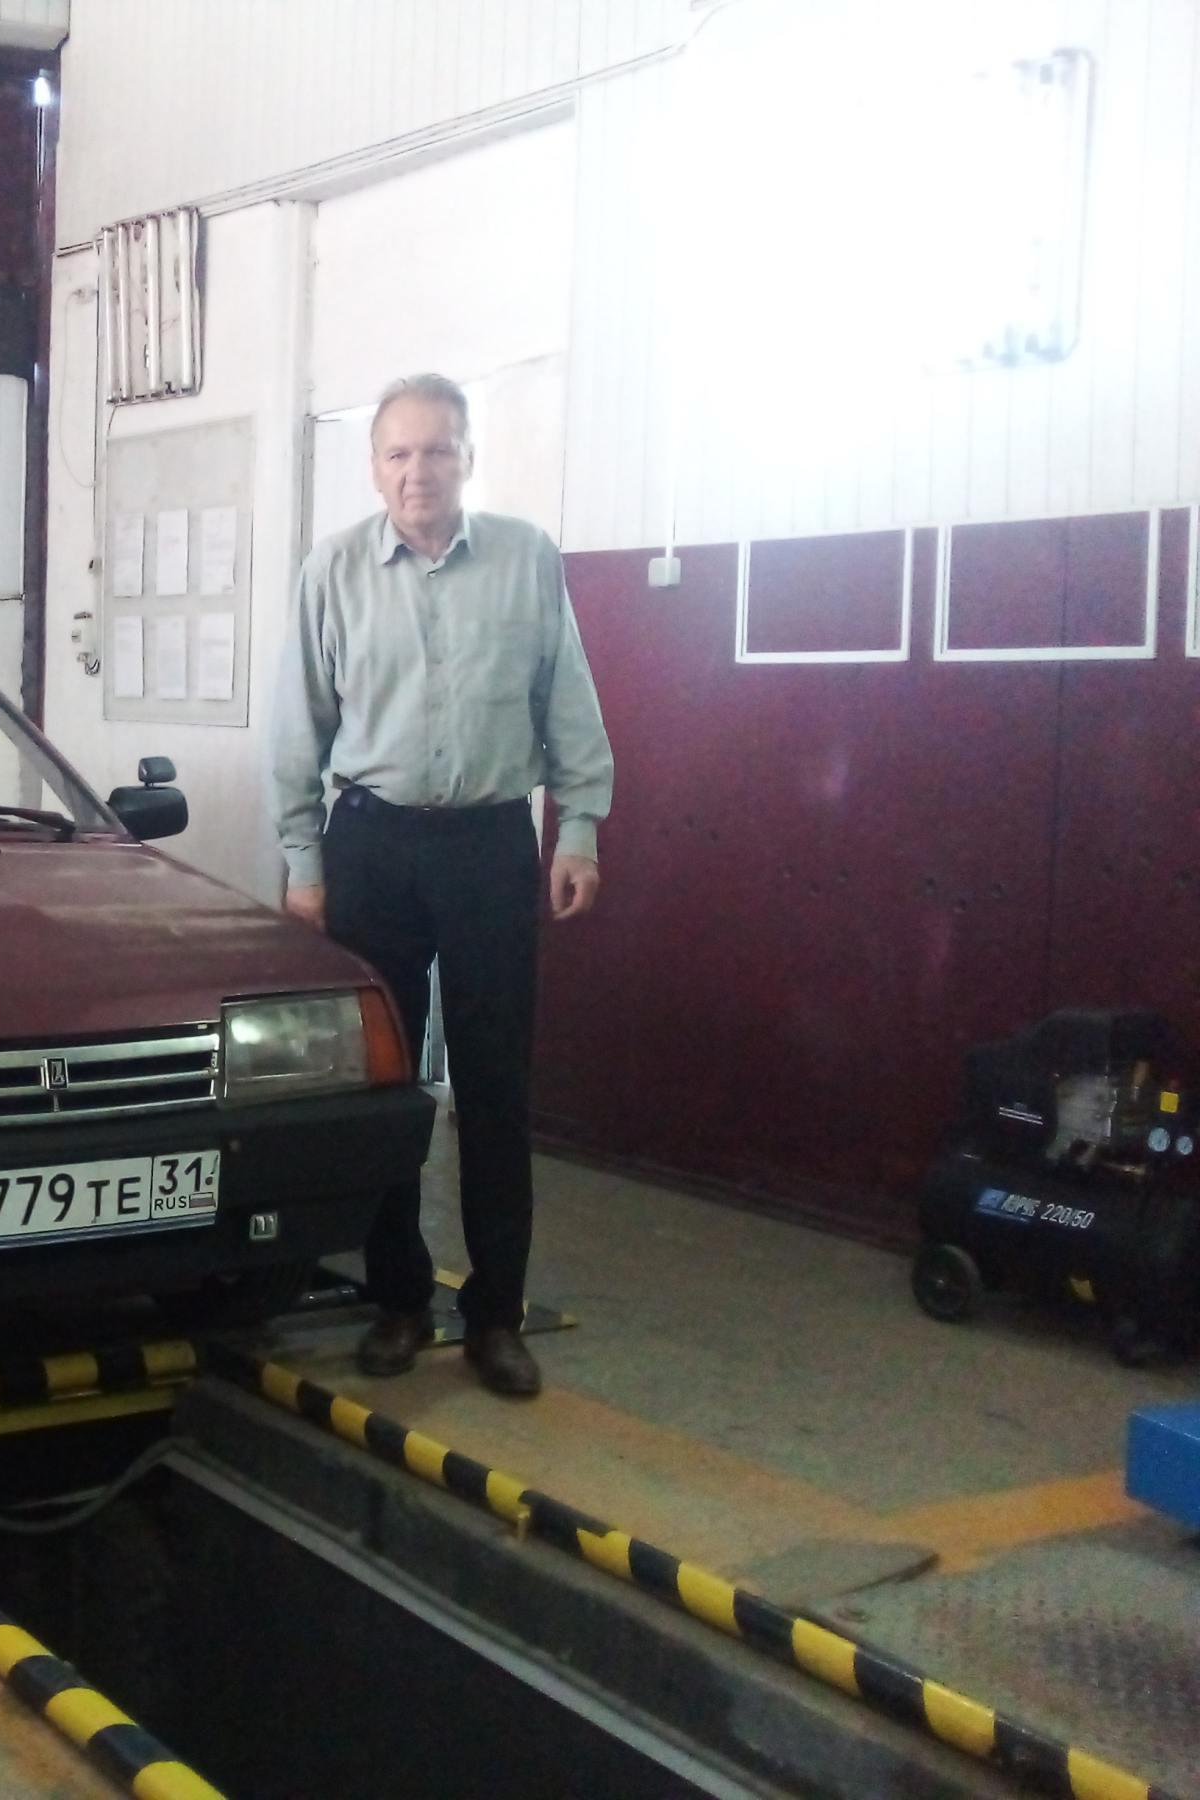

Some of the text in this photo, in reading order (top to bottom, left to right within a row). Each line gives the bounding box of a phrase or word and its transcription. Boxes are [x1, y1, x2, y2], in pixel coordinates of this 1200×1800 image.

[158, 1156, 202, 1196] 31
[154, 1195, 188, 1211] RUS
[1040, 1202, 1096, 1229] 220/50
